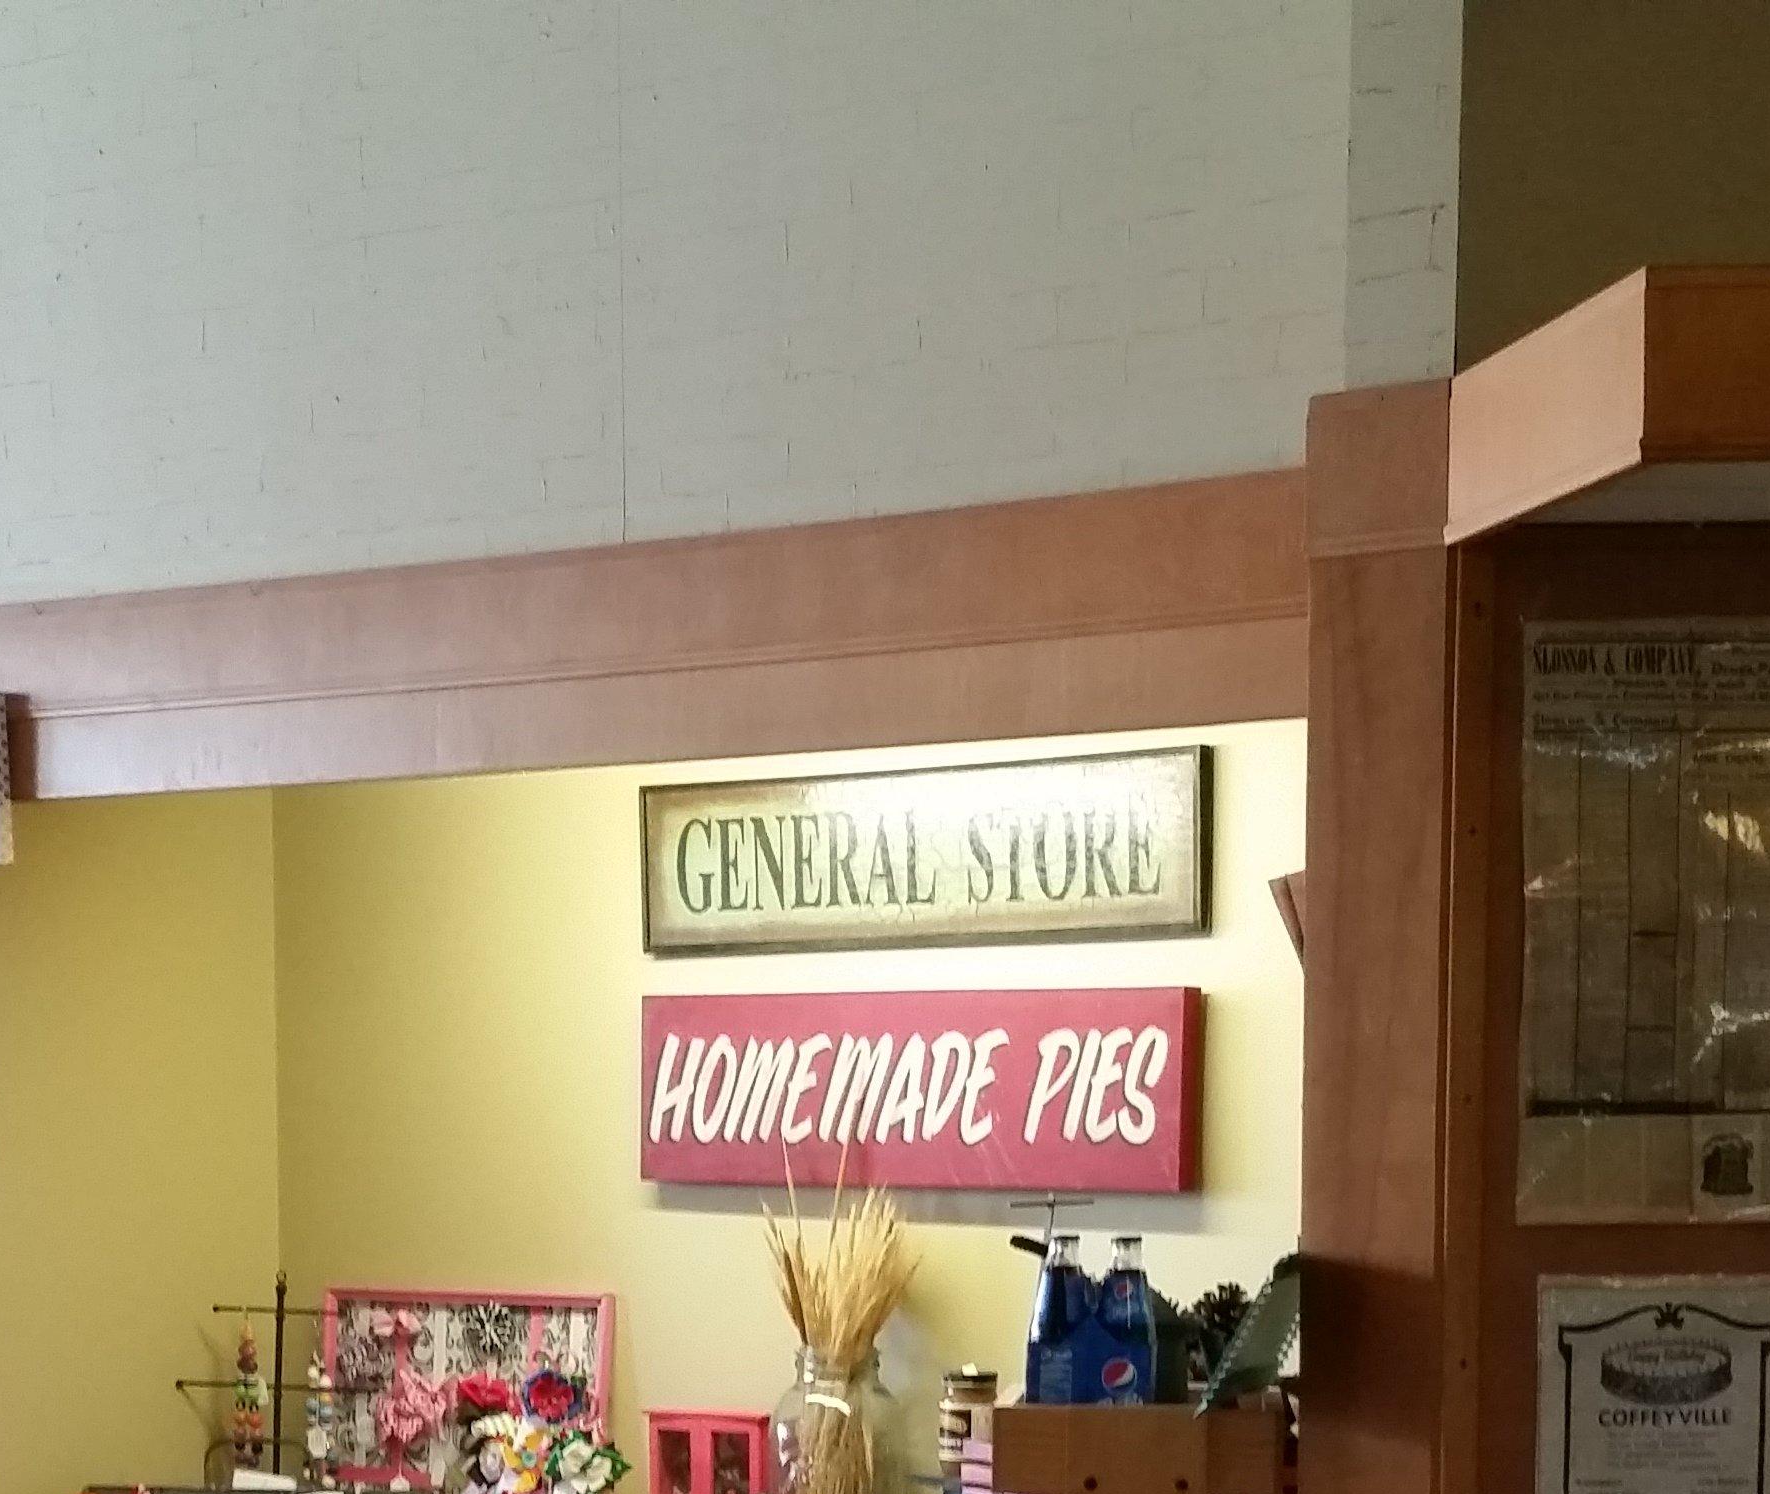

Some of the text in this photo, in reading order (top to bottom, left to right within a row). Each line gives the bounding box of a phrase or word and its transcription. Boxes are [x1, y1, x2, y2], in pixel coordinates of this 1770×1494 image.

[675, 796, 1162, 915] GENERAL STORE
[649, 1024, 1170, 1145] HOMEMADE PIES
[1597, 1408, 1733, 1429] COFFEYVILLE
